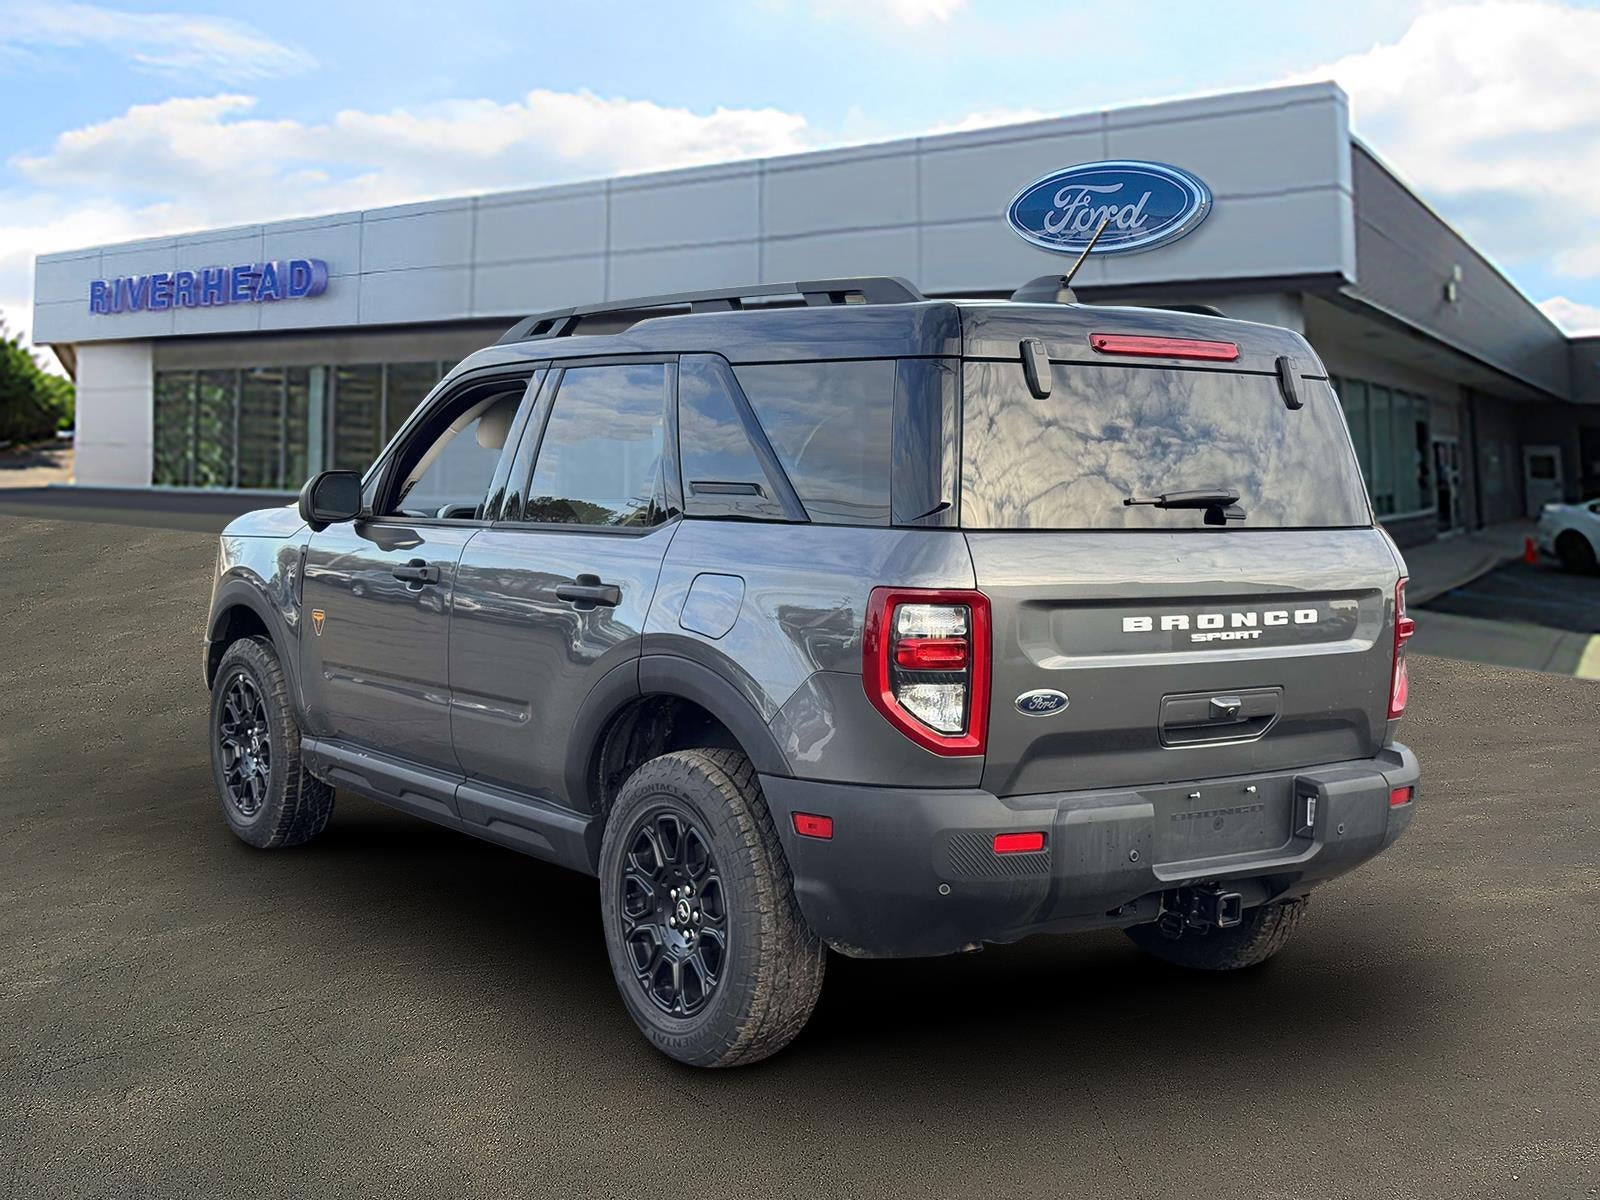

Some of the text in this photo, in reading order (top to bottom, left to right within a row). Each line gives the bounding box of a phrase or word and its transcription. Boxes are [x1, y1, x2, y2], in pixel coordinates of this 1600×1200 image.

[1043, 182, 1152, 234] Ford
[90, 258, 326, 315] RIVERHEAD
[1122, 609, 1318, 632] BRONCO
[1191, 630, 1262, 642] SPORT
[1029, 695, 1058, 710] Ford
